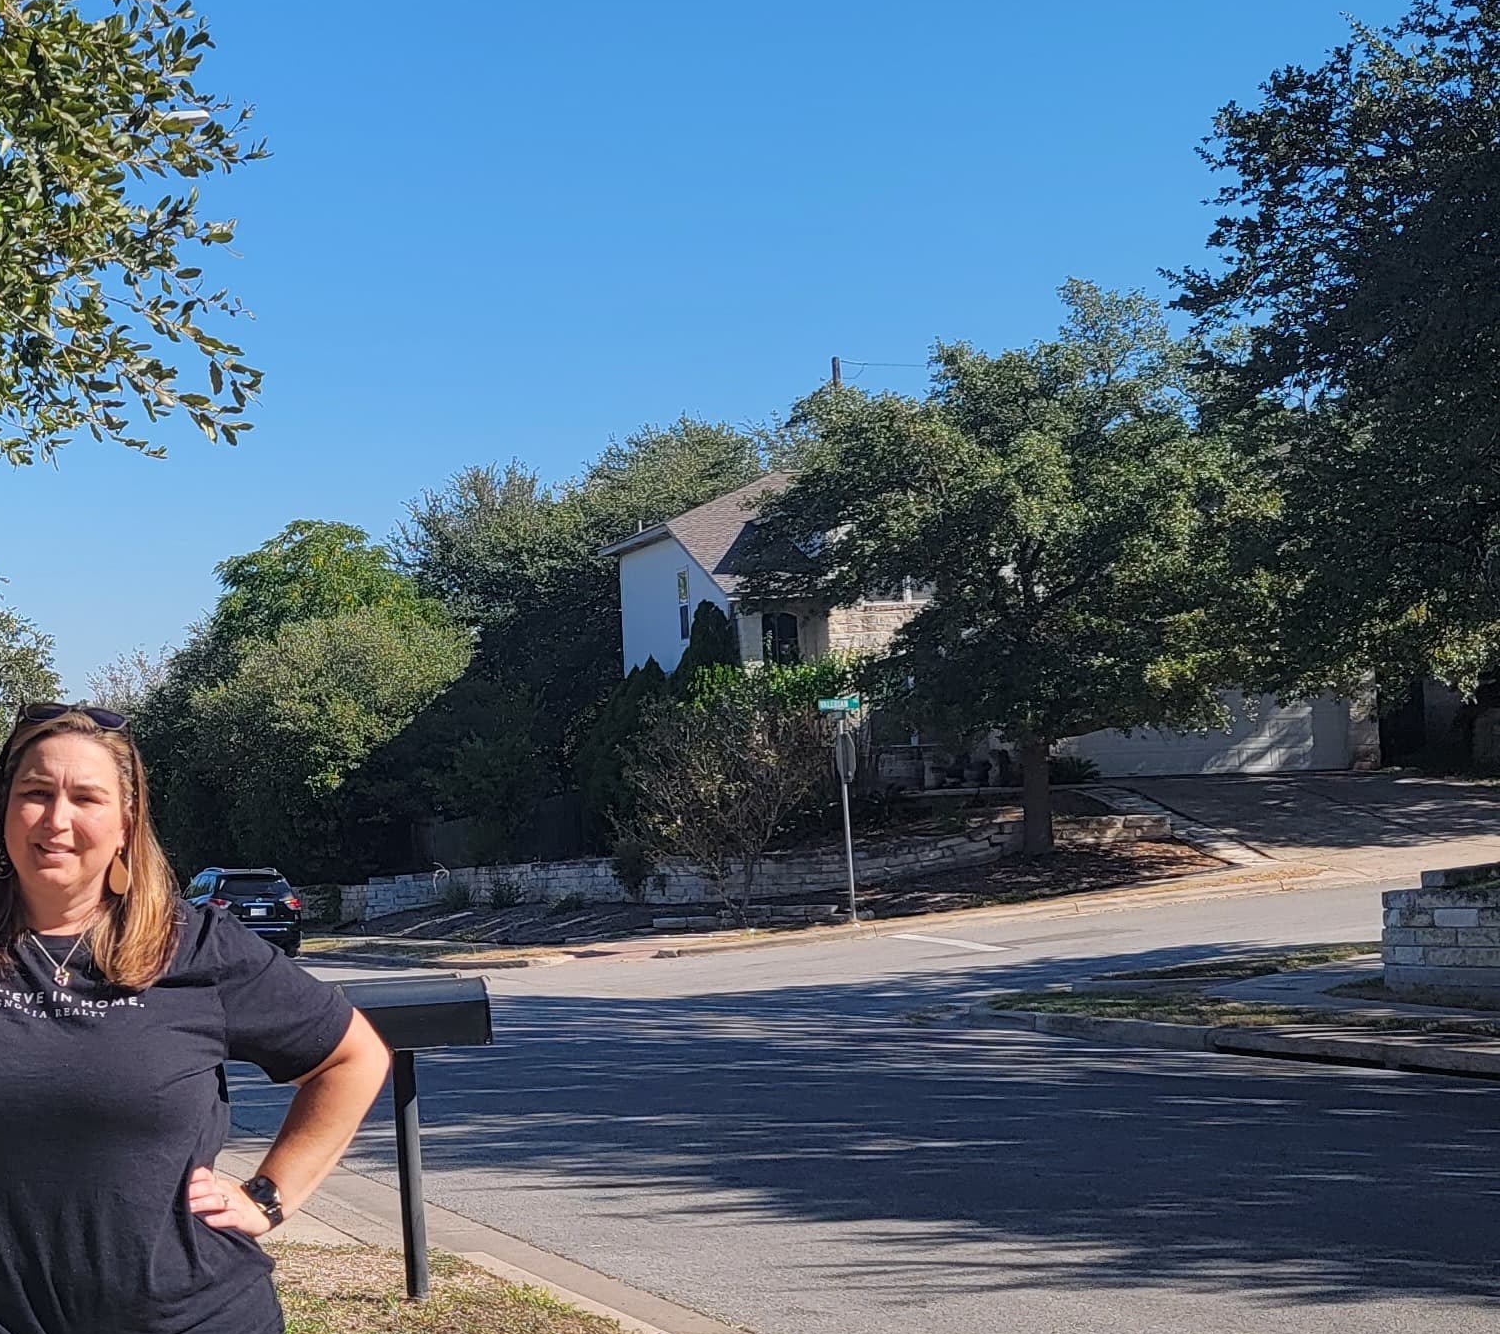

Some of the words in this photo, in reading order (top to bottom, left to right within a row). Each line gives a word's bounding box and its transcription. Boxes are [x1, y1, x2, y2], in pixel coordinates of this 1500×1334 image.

[52, 990, 73, 1003] IN
[81, 996, 146, 1009] HOME.
[55, 1007, 107, 1019] REALTY
